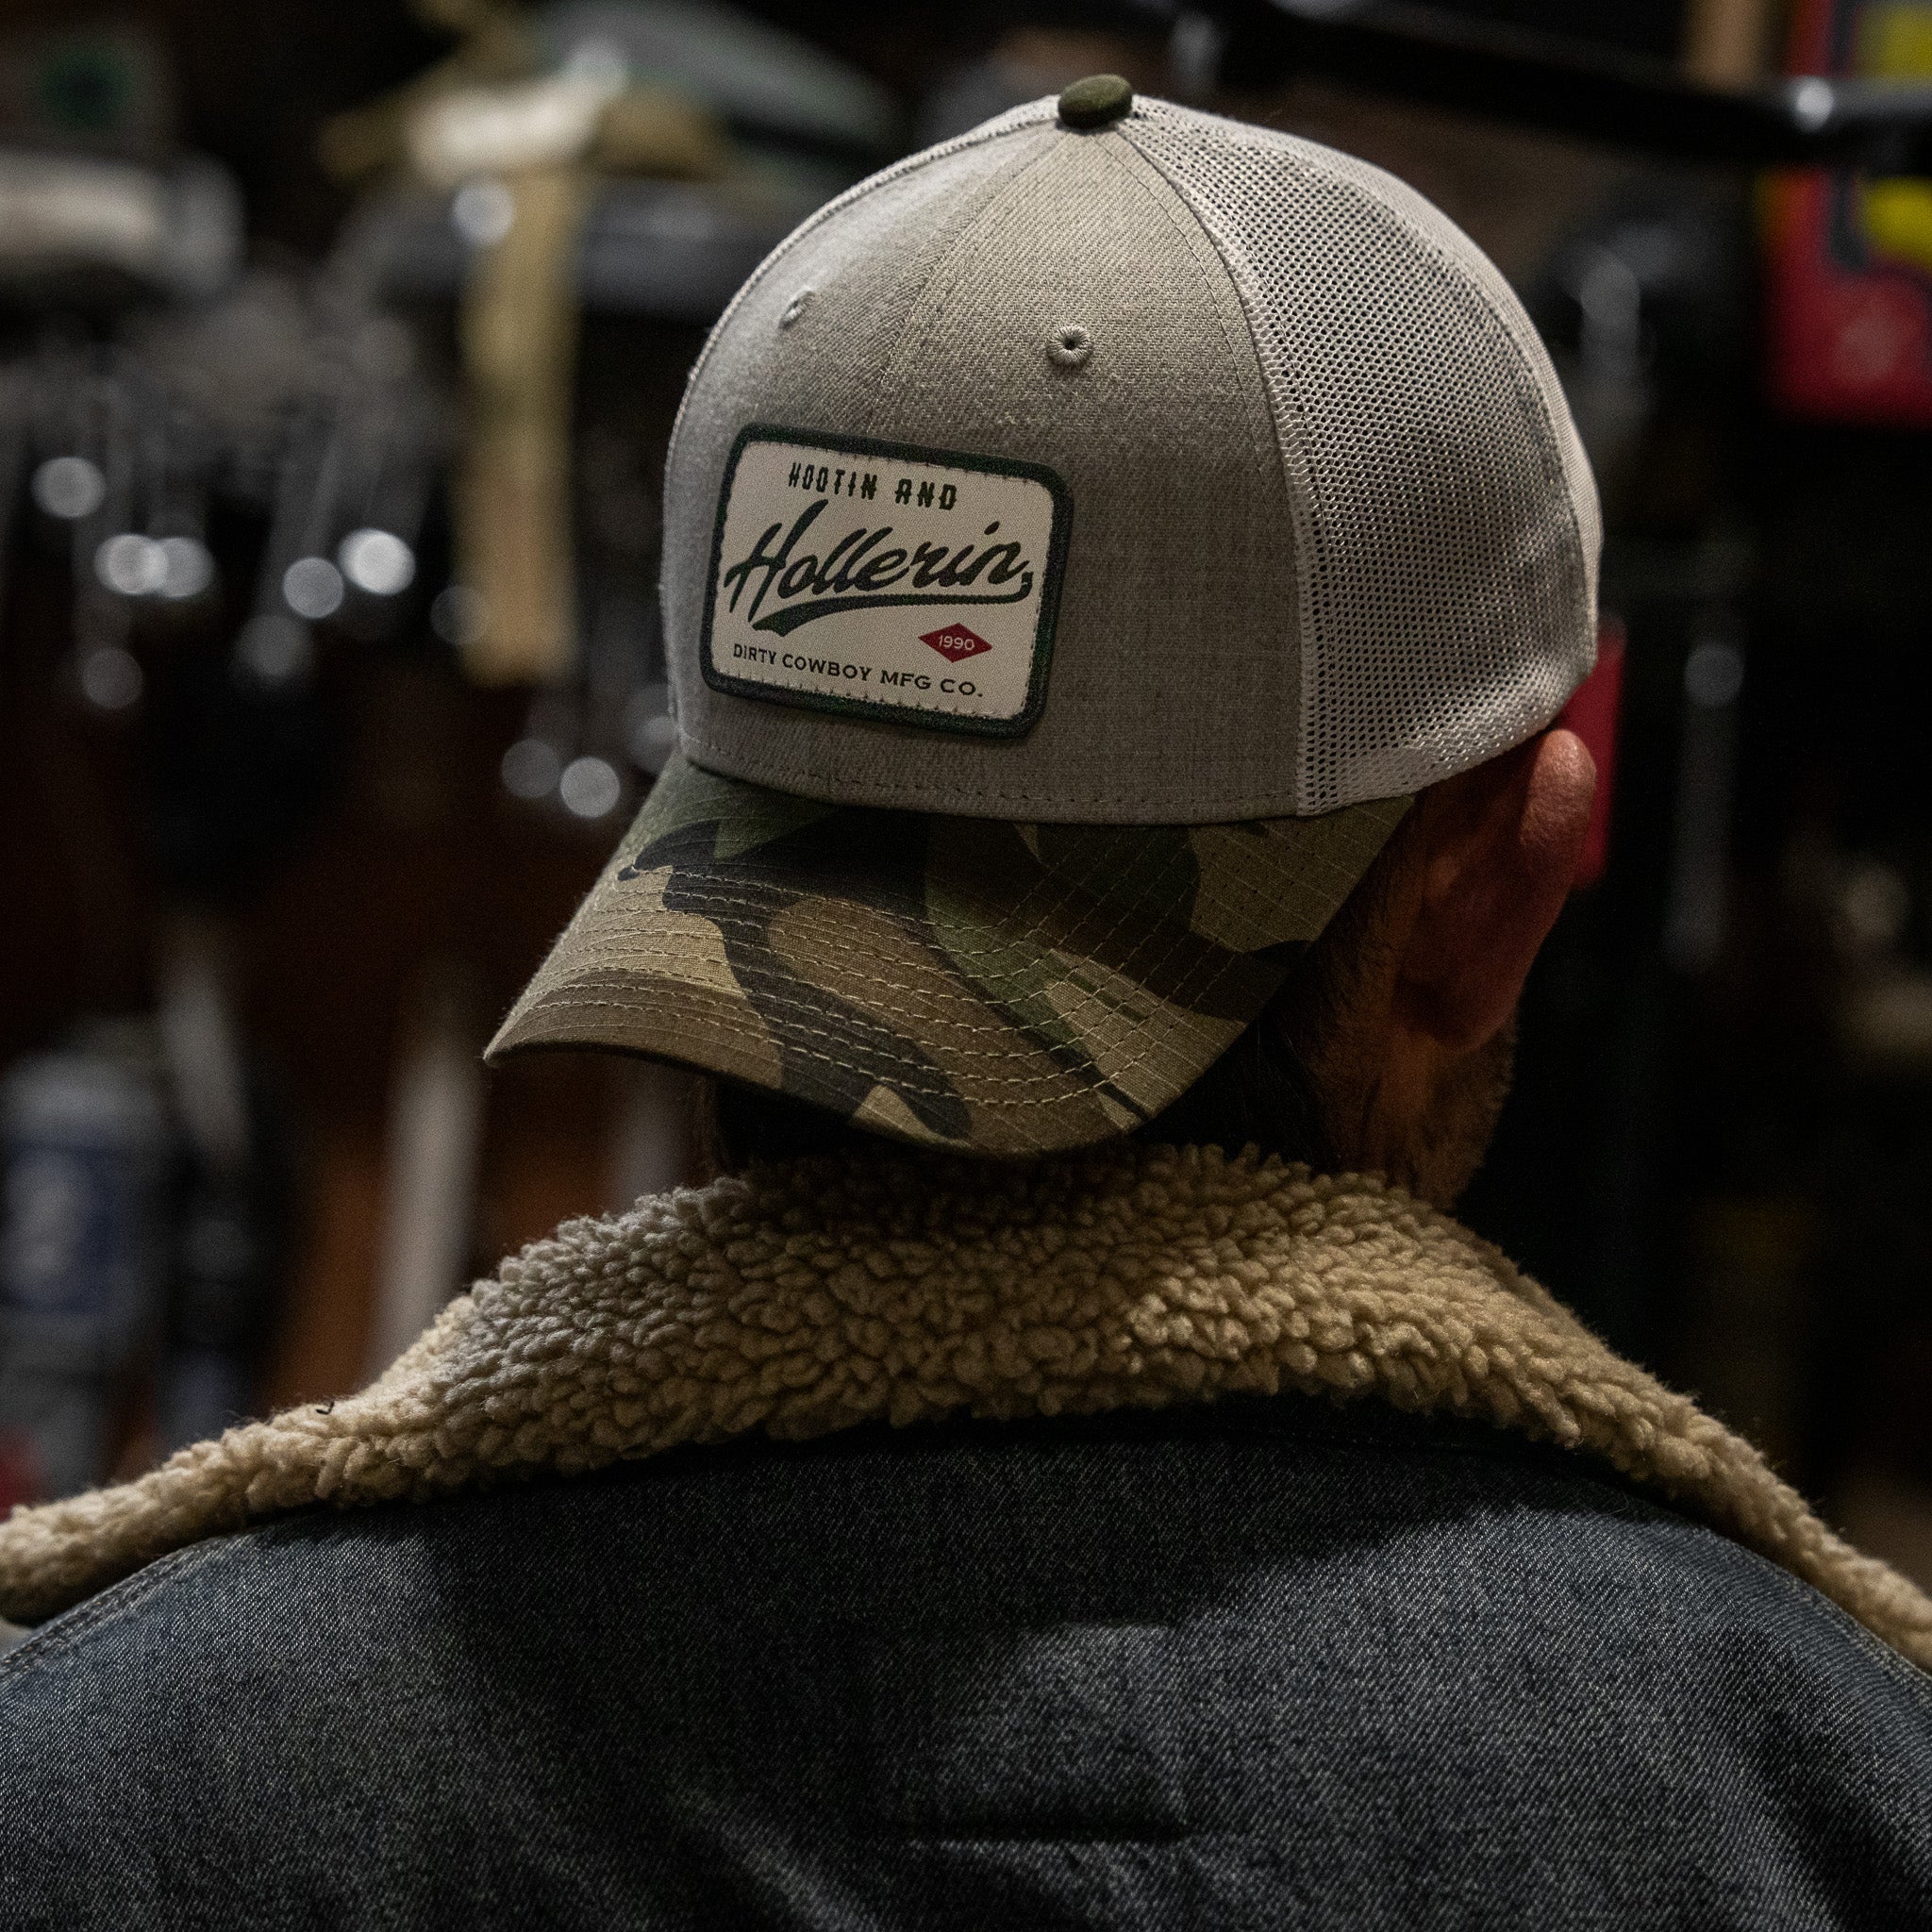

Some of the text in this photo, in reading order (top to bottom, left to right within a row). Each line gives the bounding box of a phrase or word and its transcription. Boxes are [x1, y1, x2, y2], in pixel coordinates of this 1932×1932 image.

[789, 462, 958, 510] HOOTIN AND
[724, 499, 1033, 624] Hollerin
[937, 634, 975, 652] 1990
[733, 643, 983, 698] DIRTY COWBOY MFG CO.
